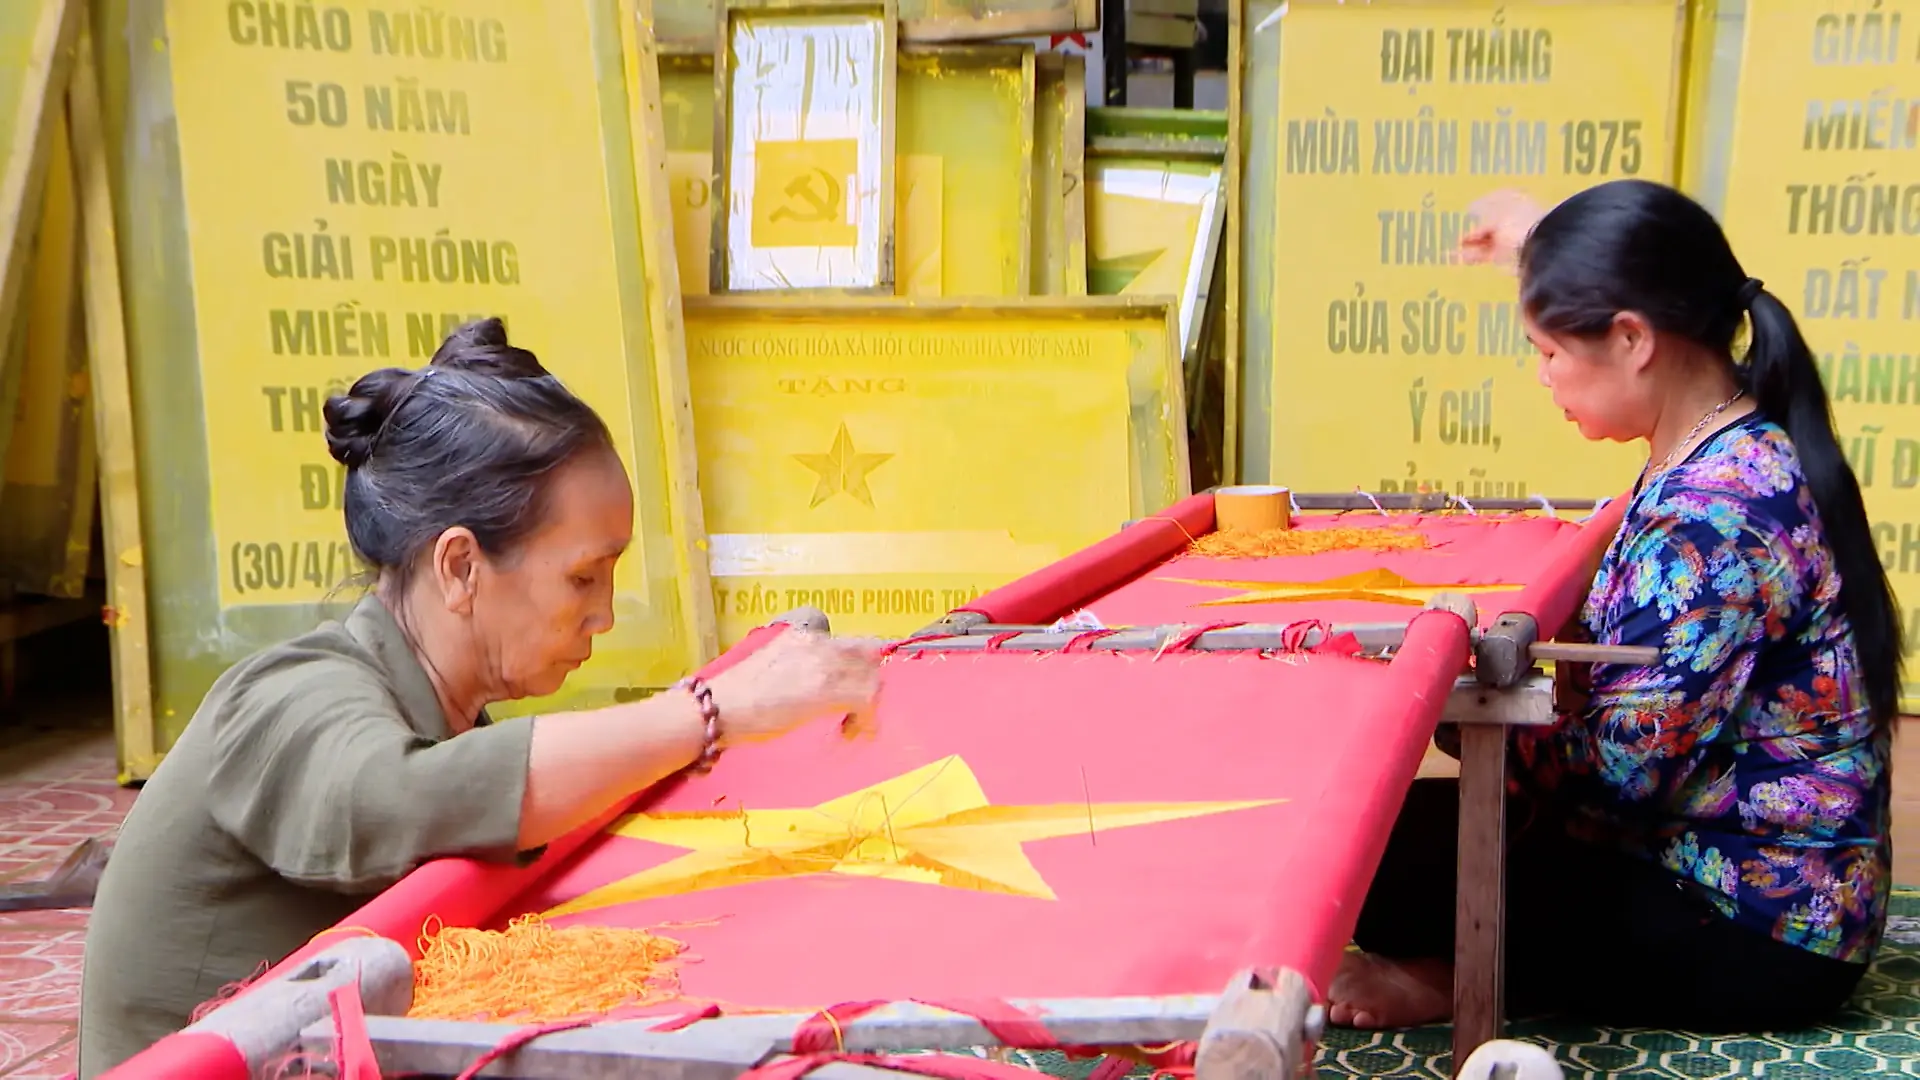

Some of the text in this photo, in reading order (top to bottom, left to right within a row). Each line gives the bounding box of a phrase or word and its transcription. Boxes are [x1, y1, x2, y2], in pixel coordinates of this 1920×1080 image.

[368, 5, 508, 63] MỪNG
[1381, 10, 1553, 95] ĐẠI THẮNG
[285, 75, 471, 136] 50 NĂM
[1286, 106, 1642, 175] MÙA XUÂN NĂM 1975
[325, 150, 442, 208] NGÀY
[263, 217, 520, 285] GIẢI PHÓNG
[269, 300, 390, 357] MIỀN
[1054, 335, 1092, 358] NAM
[1327, 282, 1390, 356] CỦA
[1401, 289, 1467, 356] SỨC
[1408, 376, 1501, 453] Ý CHÍ,
[862, 588, 935, 615] PHONG
